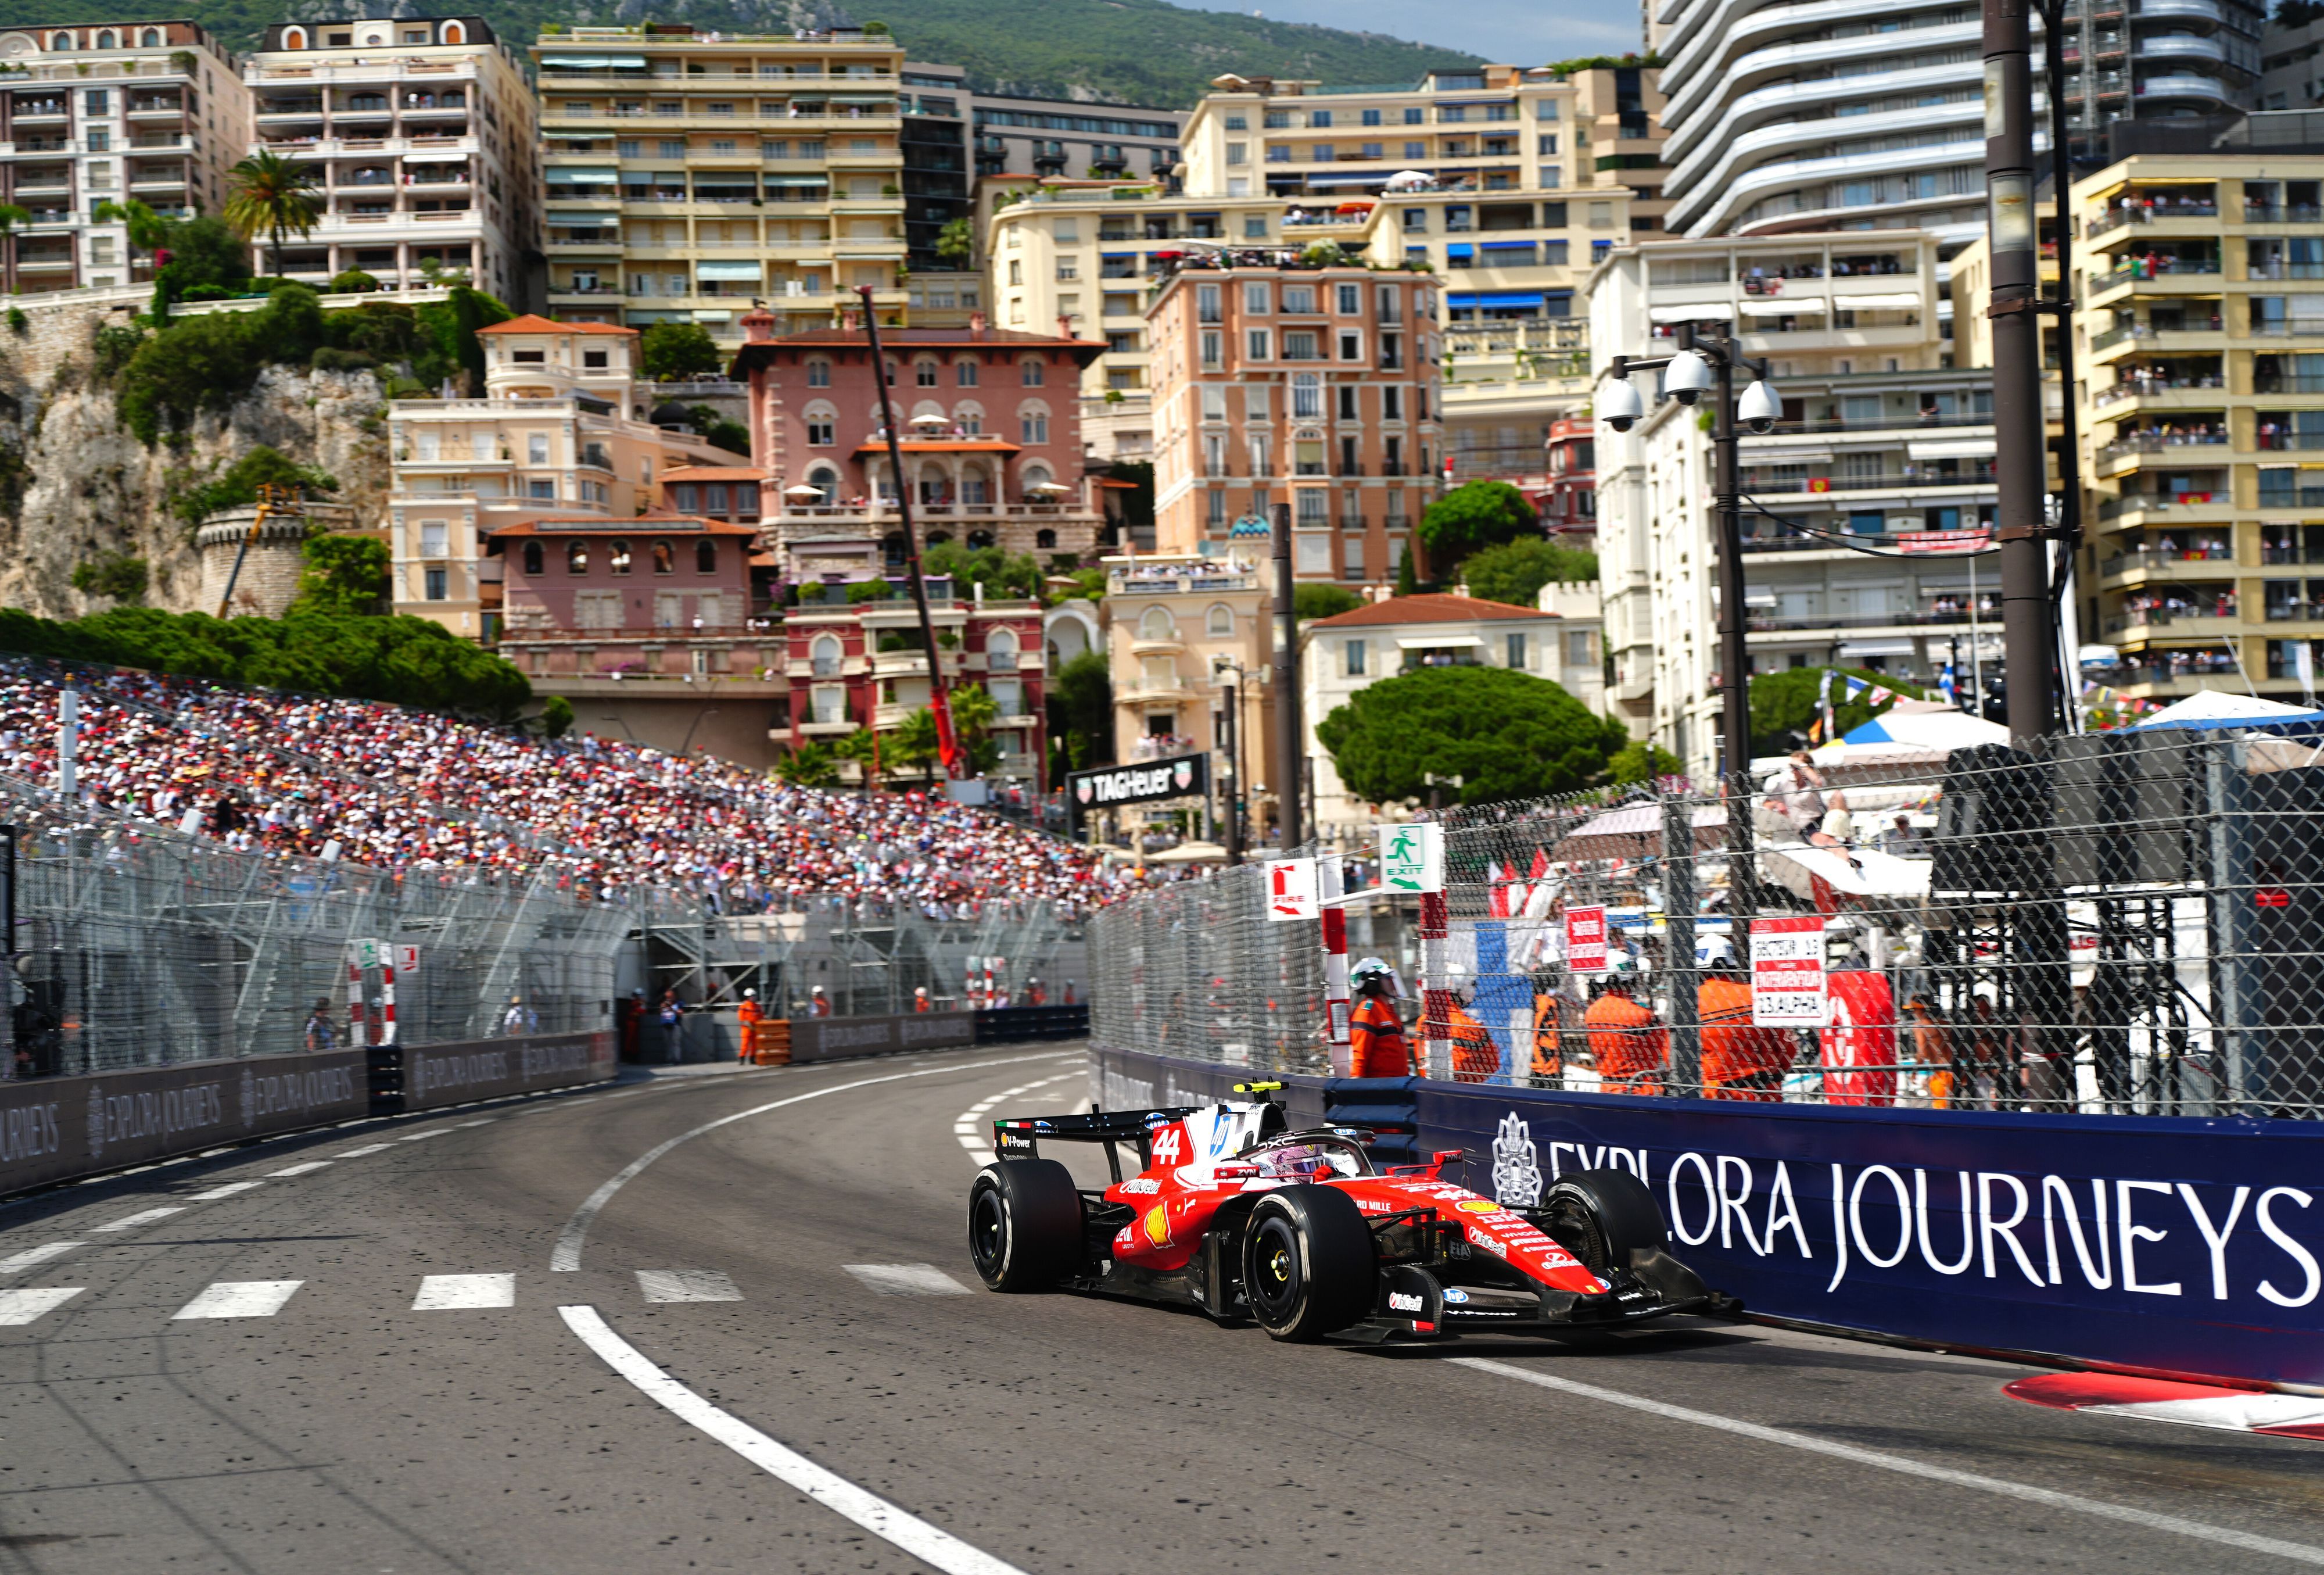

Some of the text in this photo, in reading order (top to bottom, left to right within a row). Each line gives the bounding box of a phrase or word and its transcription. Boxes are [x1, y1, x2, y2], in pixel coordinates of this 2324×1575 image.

[1386, 867, 1424, 876] EXIT
[1007, 1136, 1030, 1148] V-Power
[1210, 1116, 1231, 1157] hp
[1153, 1129, 1181, 1165] 44
[1237, 1168, 1257, 1176] ZYN
[1433, 1189, 1477, 1200] 44
[1368, 1201, 1391, 1212] MILLE
[1476, 1214, 1523, 1224] IBM
[1827, 1163, 2322, 1307] JOURNEYS
[1476, 1230, 1507, 1259] UniCredit
[1447, 1290, 1464, 1302] hp
